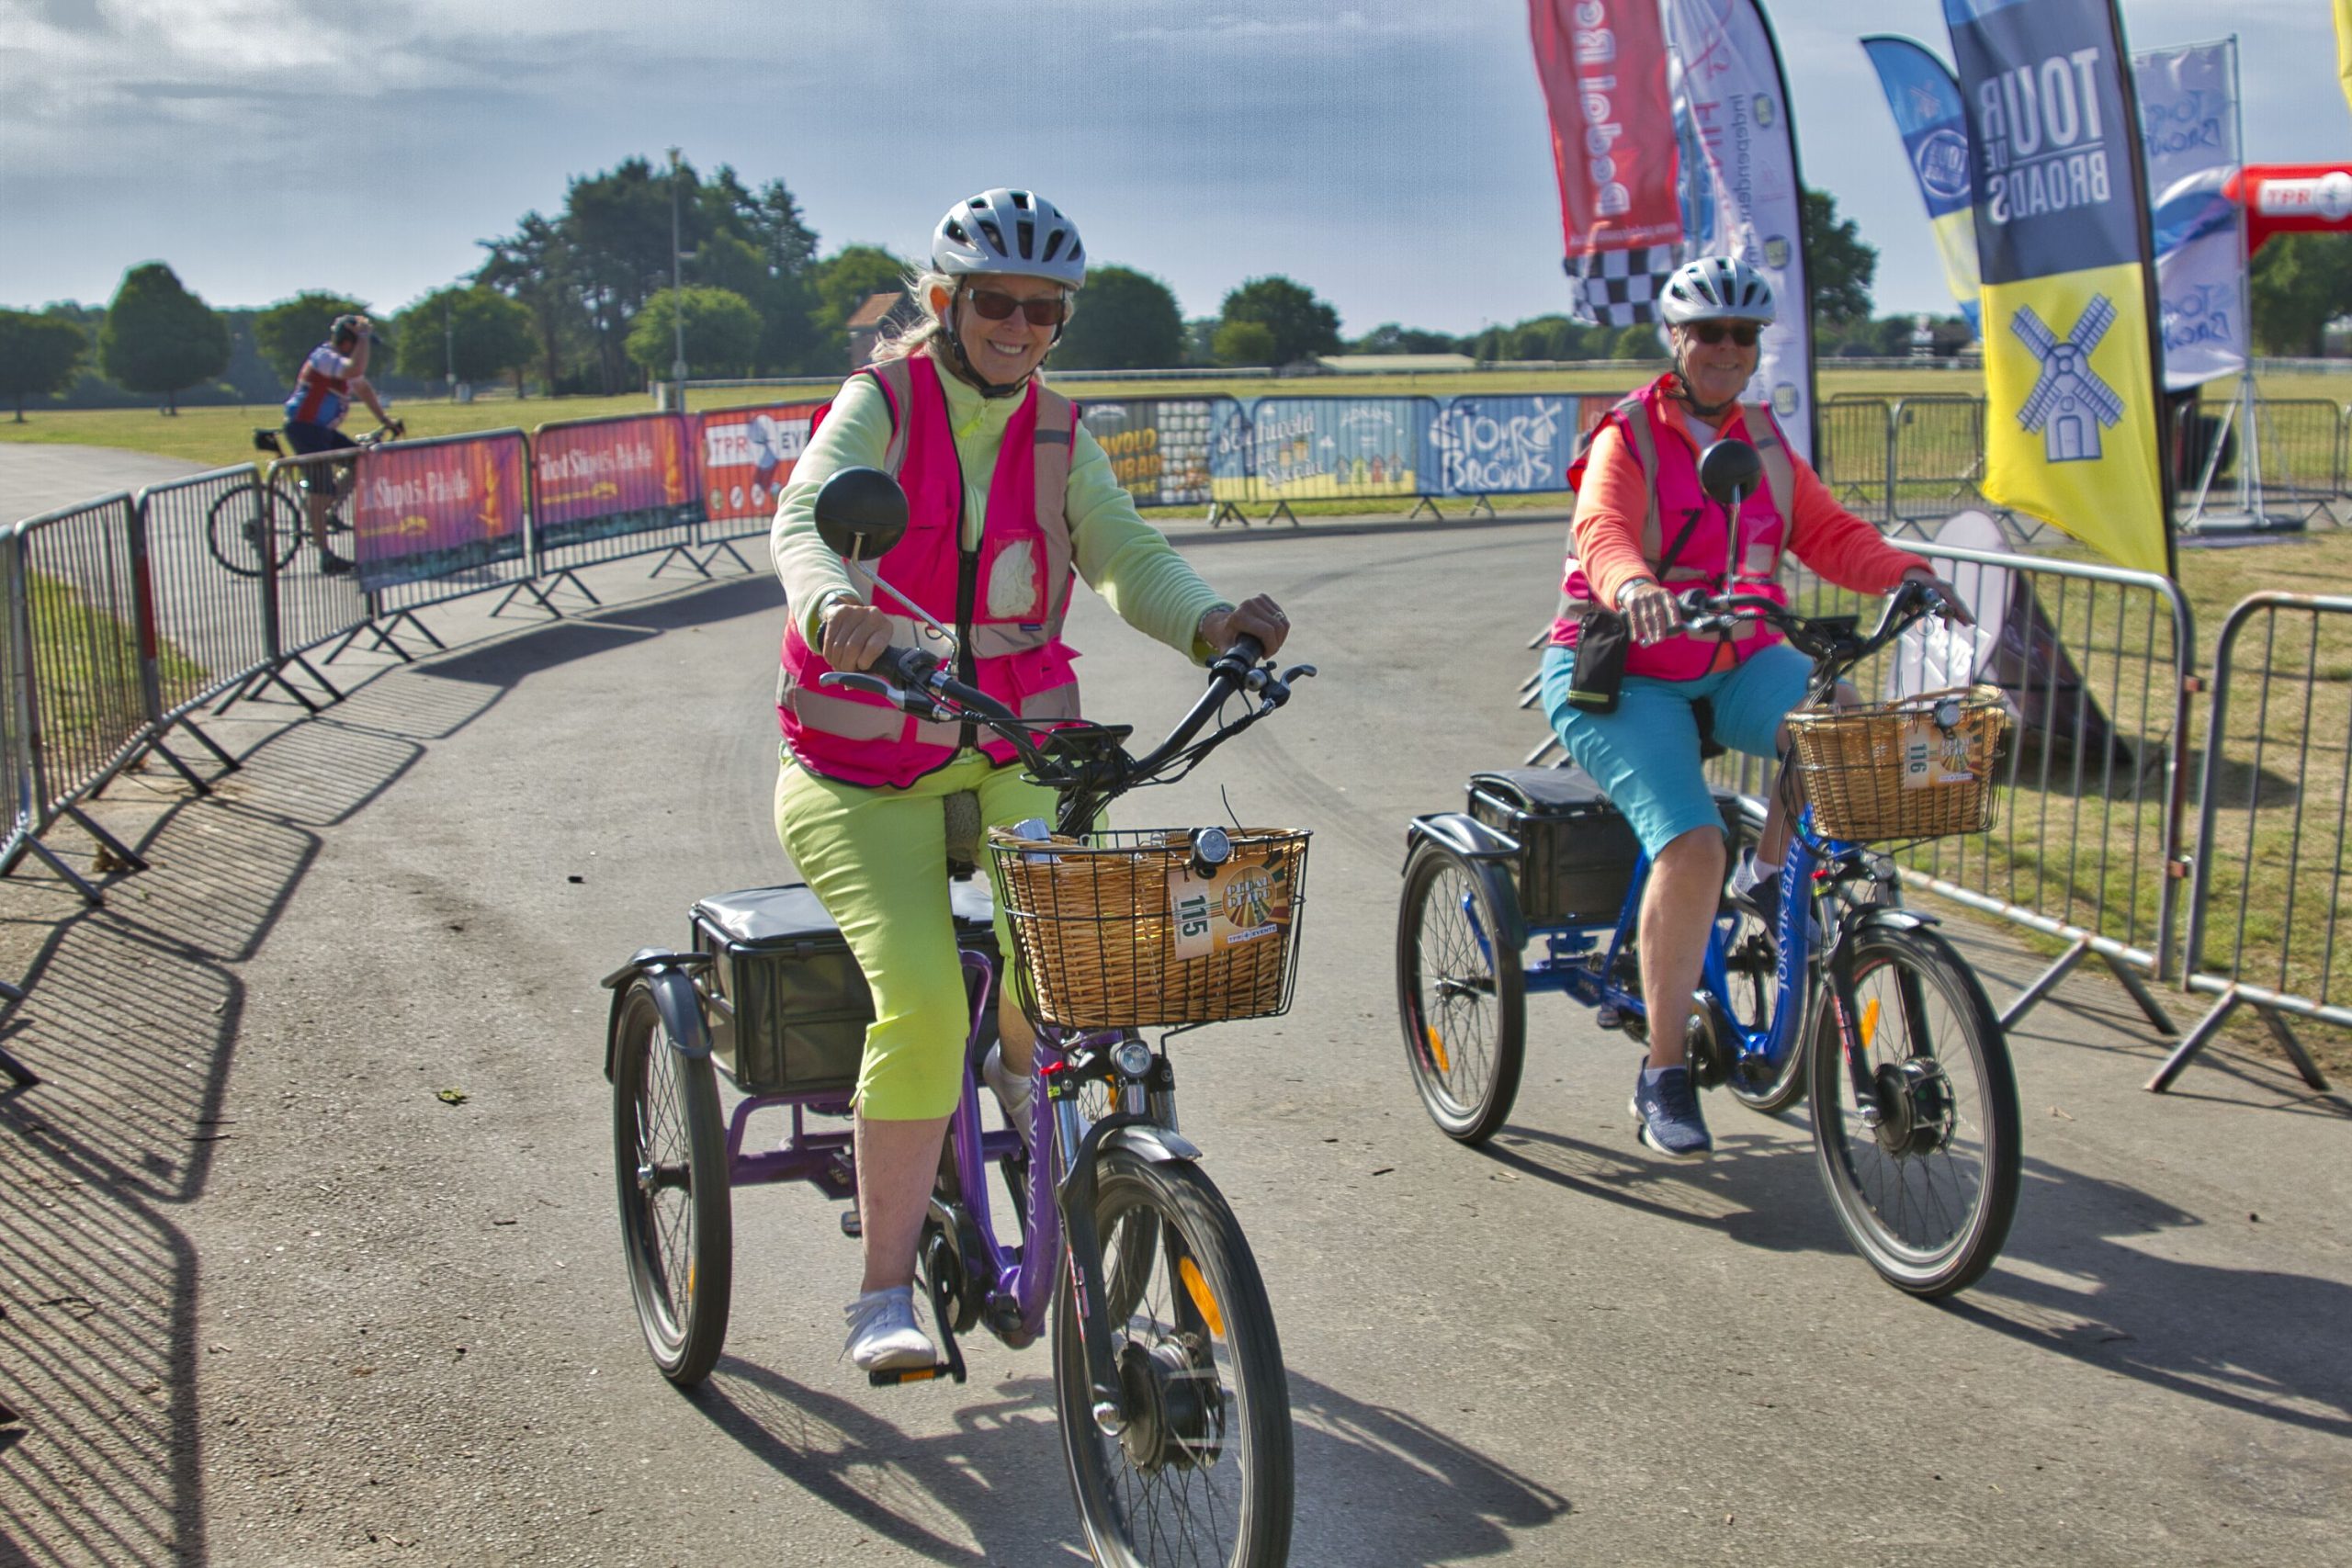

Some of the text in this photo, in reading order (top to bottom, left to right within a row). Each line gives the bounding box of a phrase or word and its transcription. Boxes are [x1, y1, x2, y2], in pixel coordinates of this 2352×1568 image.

[2267, 187, 2312, 207] TPR
[1910, 742, 1928, 773] 116
[1181, 894, 1209, 938] 115
[1251, 925, 1277, 937] EVENTS
[1776, 905, 1792, 994] JORVIK
[1026, 1115, 1039, 1235] JORVIK
